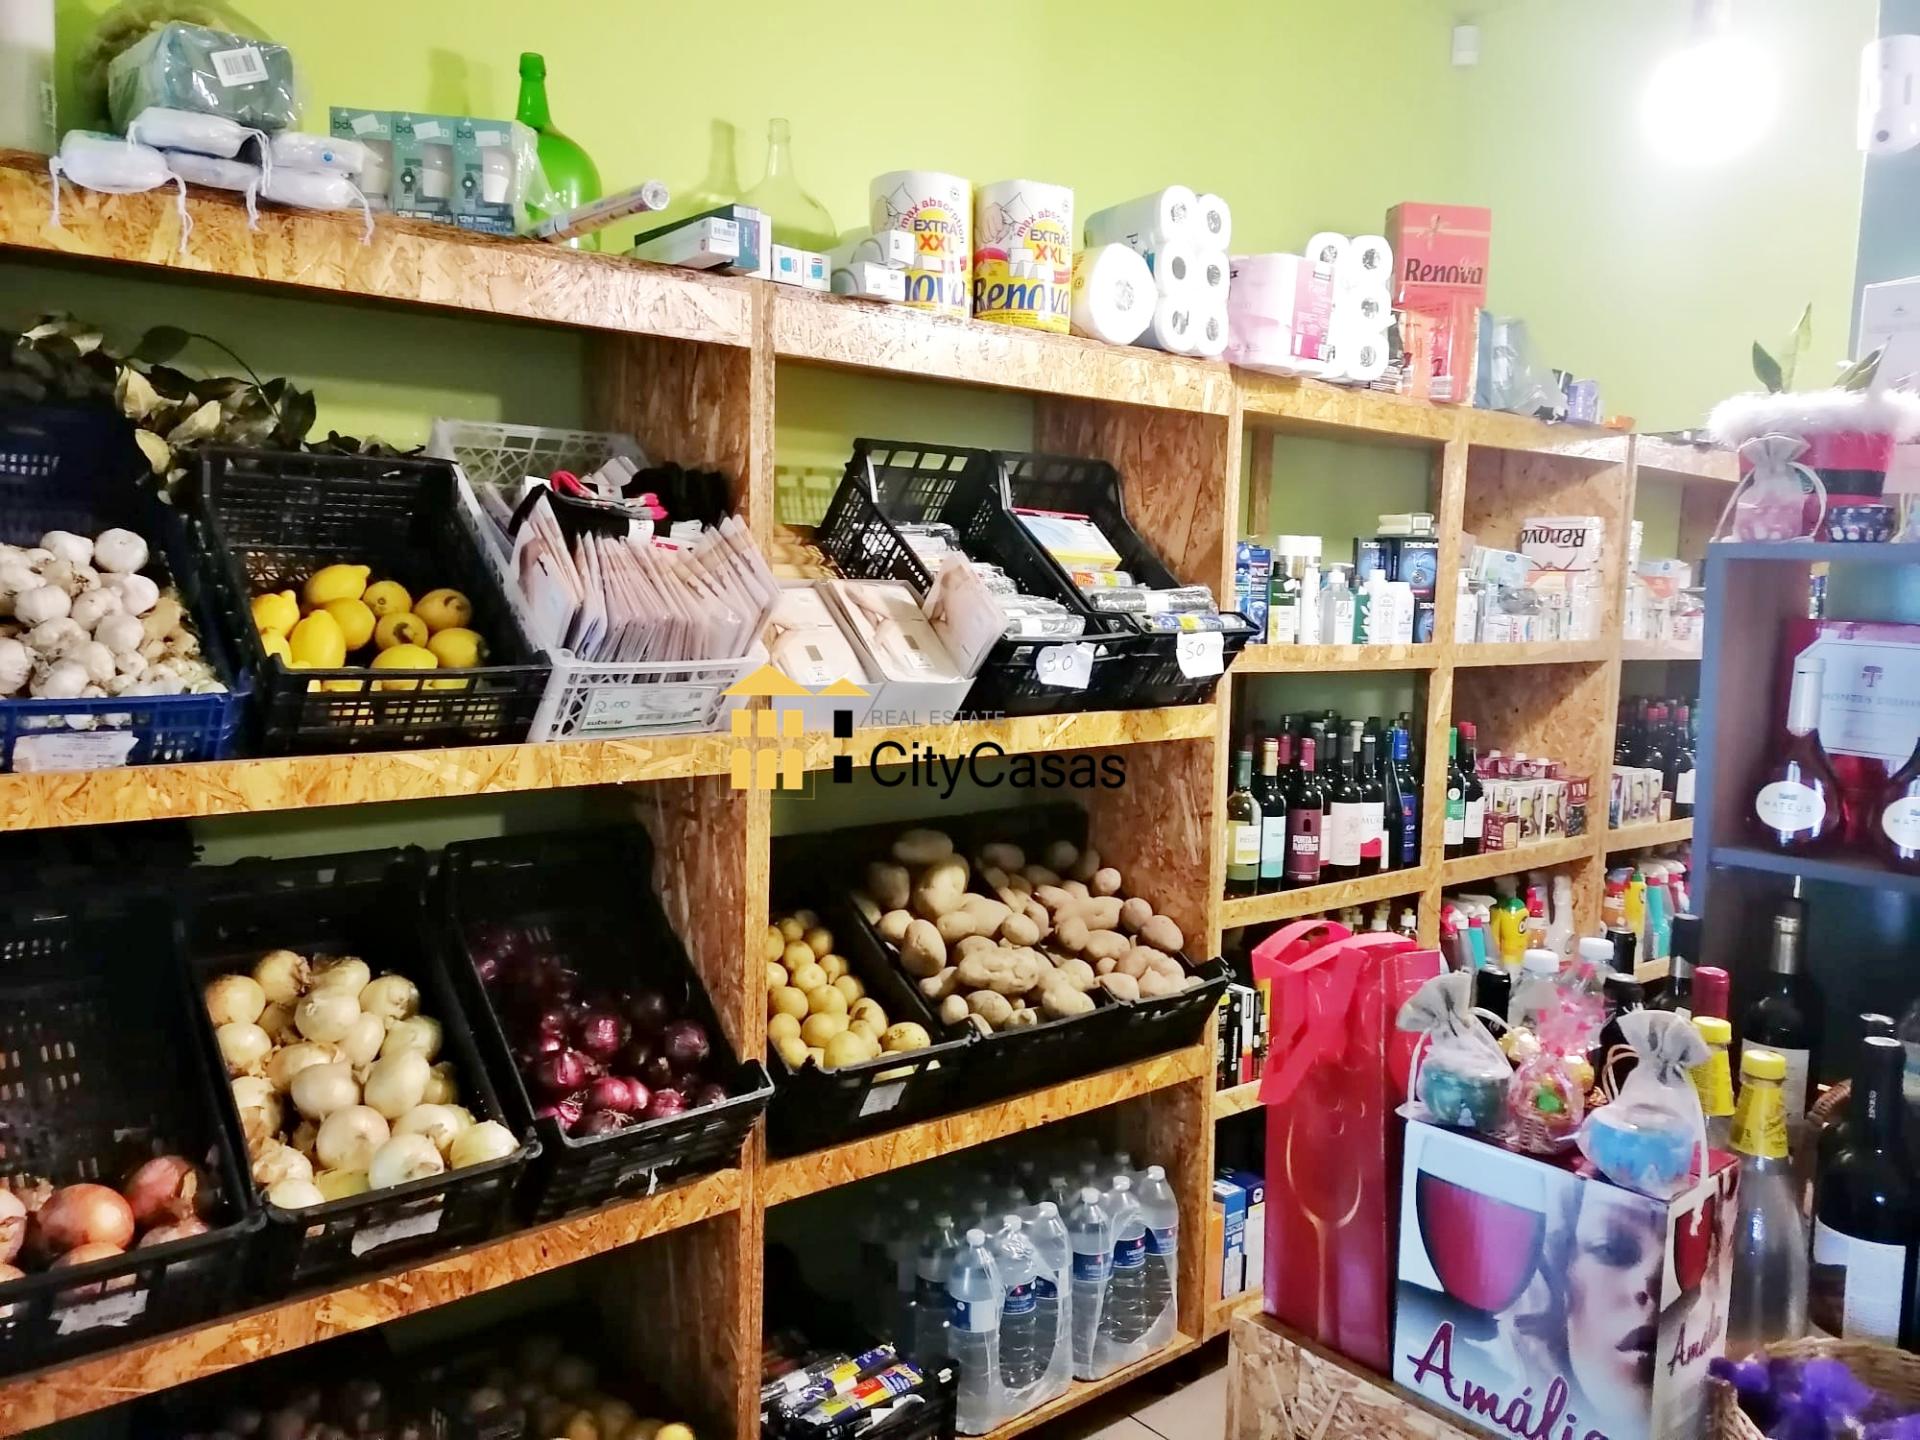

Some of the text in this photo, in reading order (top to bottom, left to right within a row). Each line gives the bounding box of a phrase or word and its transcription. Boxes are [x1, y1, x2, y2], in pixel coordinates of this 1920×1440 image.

[900, 204, 920, 230] max
[914, 219, 959, 236] EXTRA
[1016, 214, 1036, 238] max
[919, 233, 955, 255] XXL
[1030, 229, 1066, 246] EXTRA
[1035, 243, 1066, 265] XXL
[1405, 258, 1484, 285] Renova
[973, 277, 1070, 316] Renova
